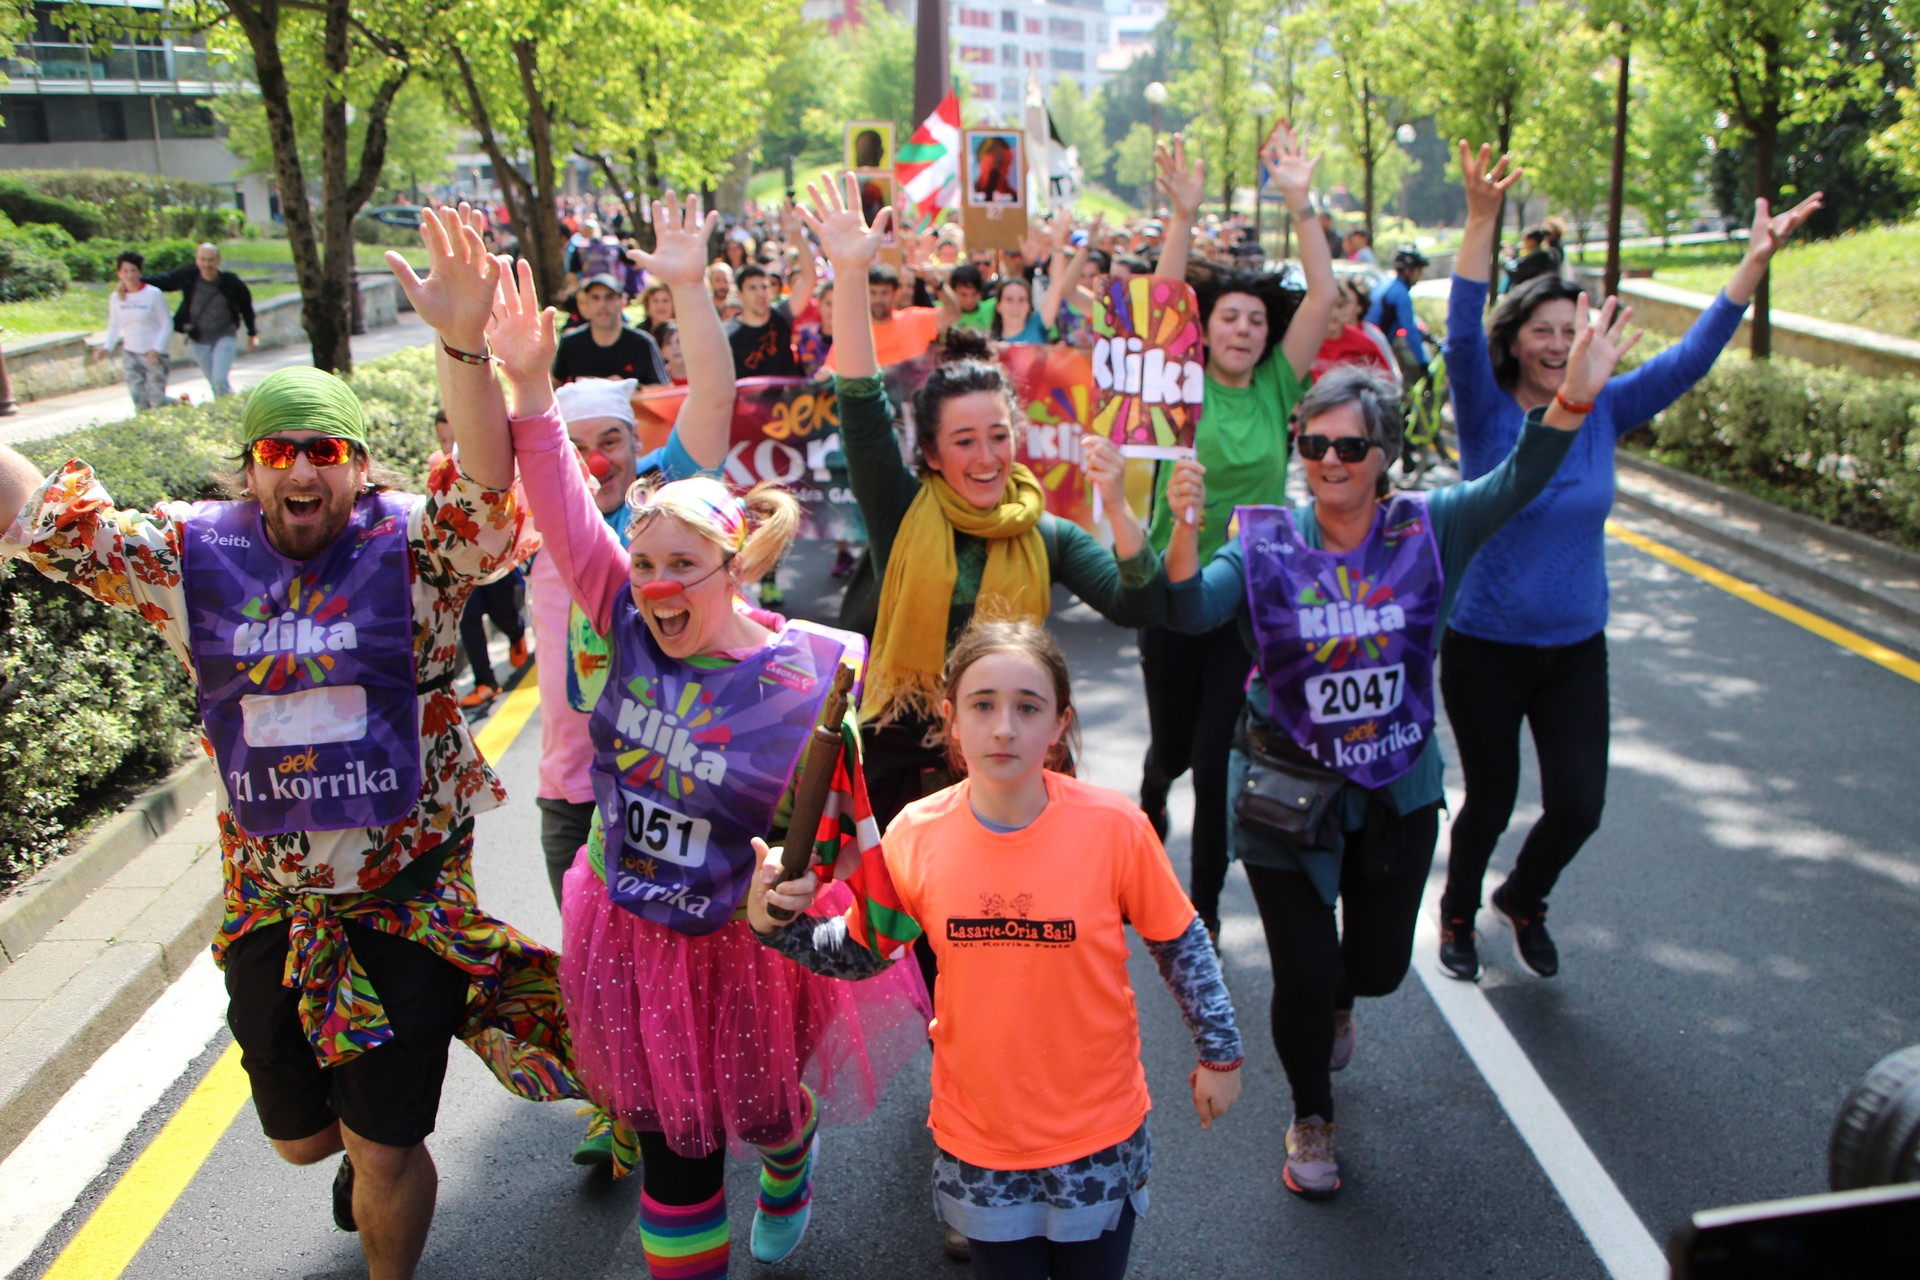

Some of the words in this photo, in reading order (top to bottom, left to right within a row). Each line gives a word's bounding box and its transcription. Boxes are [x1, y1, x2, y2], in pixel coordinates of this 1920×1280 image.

[762, 389, 841, 440] aek
[1026, 421, 1089, 473] Kli
[218, 534, 252, 549] eitb
[232, 611, 359, 658] Klika
[1298, 600, 1406, 640] Klika
[1319, 670, 1400, 716] 2047
[614, 697, 728, 786] Klika
[1333, 720, 1423, 768] korrika
[1344, 718, 1379, 743] aek
[267, 759, 400, 801] korrika
[277, 745, 320, 774] aek
[621, 791, 694, 857] 051
[624, 853, 659, 881] aek
[949, 921, 1039, 939] Lasarte-Oria
[1042, 922, 1073, 941] Bai!
